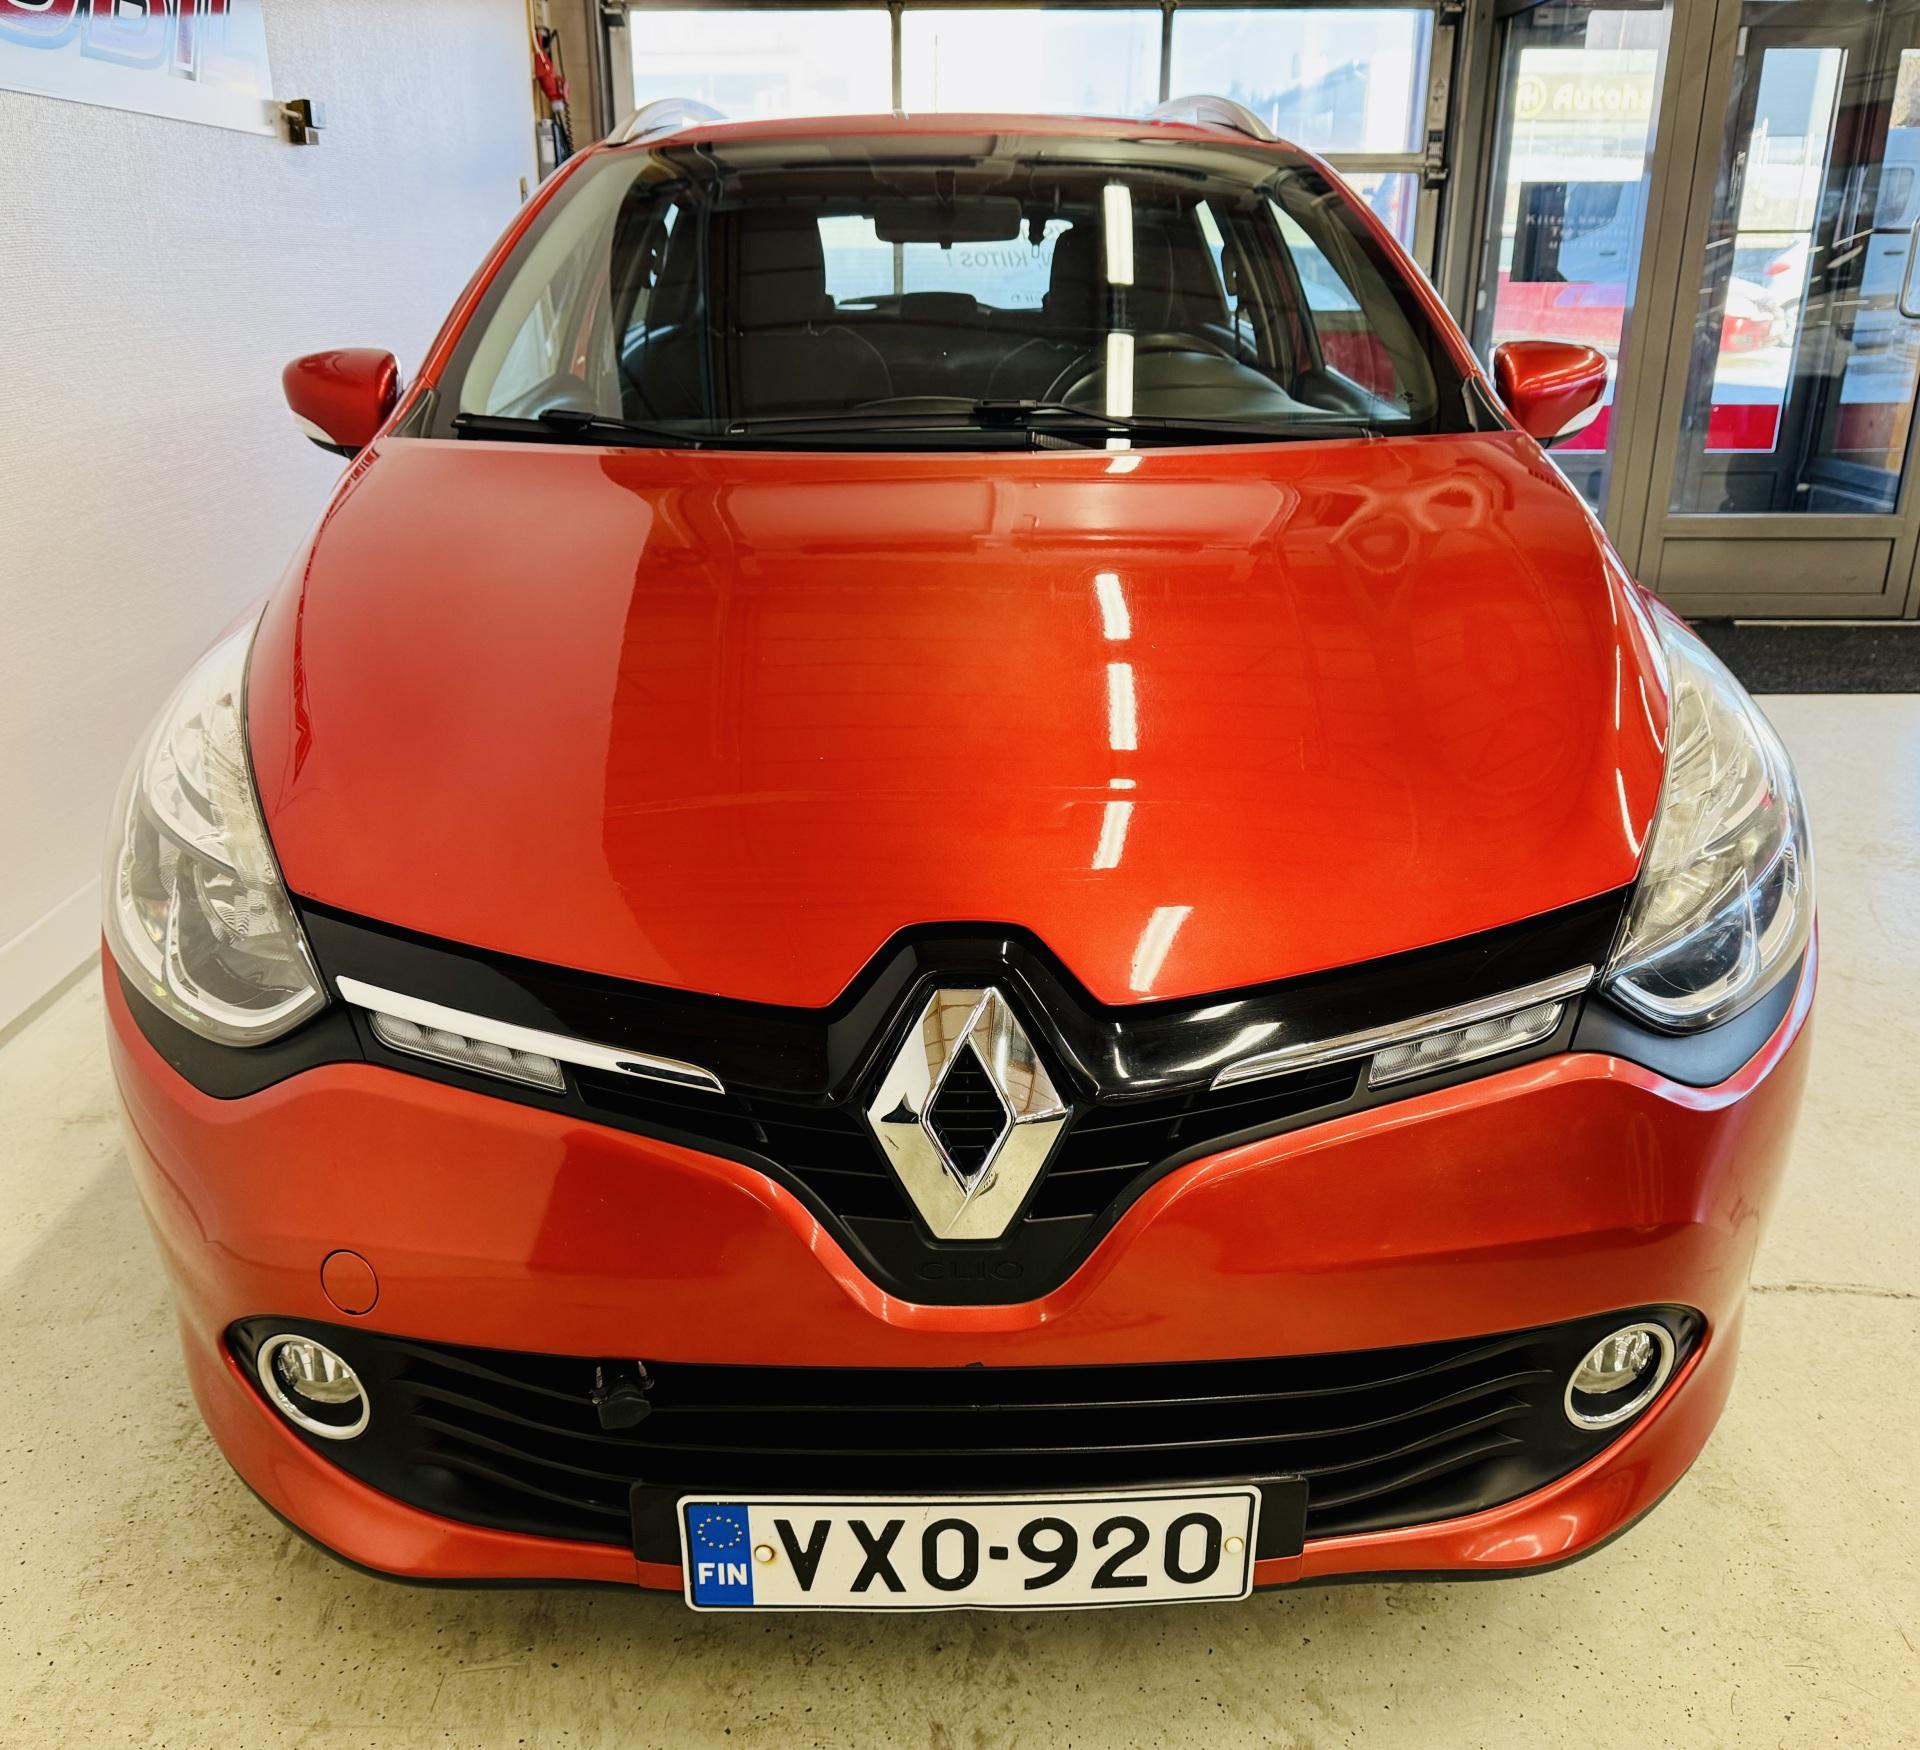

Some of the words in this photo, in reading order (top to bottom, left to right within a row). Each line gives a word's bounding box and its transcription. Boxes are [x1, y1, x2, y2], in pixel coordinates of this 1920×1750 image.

[912, 1260, 1024, 1280] CLIO
[773, 1512, 1222, 1593] VXO-920
[697, 1562, 748, 1586] FIN
